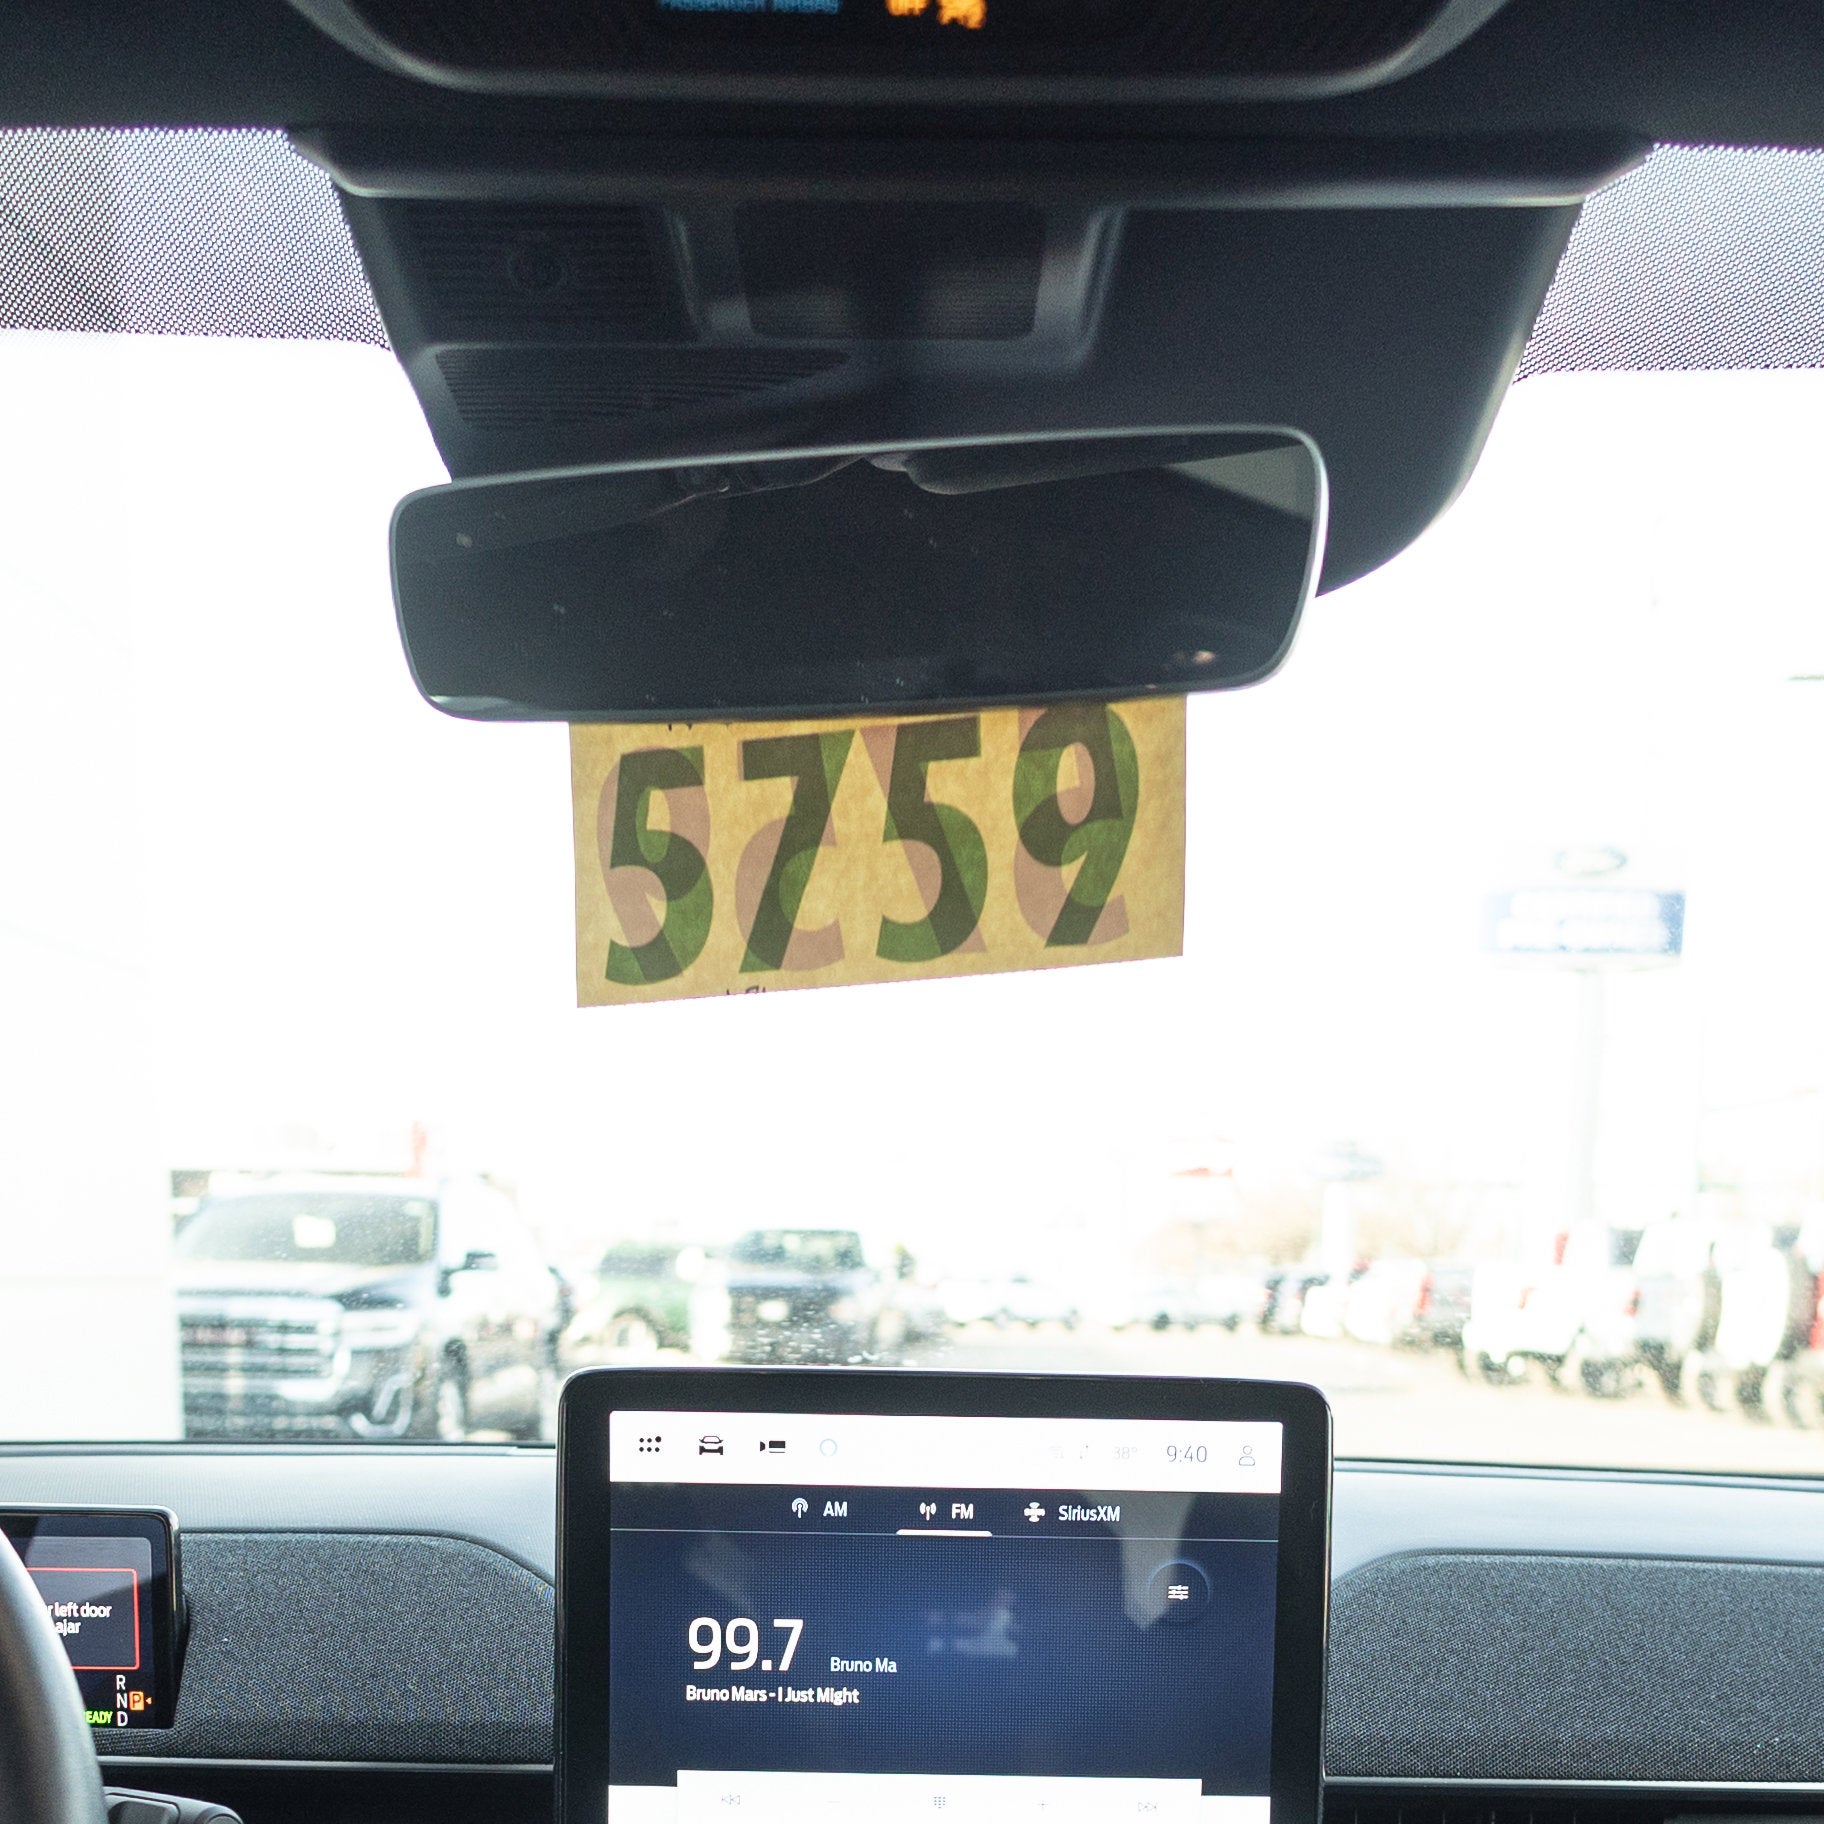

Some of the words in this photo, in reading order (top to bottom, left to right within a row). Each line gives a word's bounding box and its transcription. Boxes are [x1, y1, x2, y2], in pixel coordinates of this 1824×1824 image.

[604, 704, 1140, 986] 5759
[1166, 1443, 1209, 1463] 9:40
[822, 1501, 848, 1518] AM
[950, 1503, 974, 1521] FM
[1057, 1504, 1121, 1523] SiriusXM
[55, 1602, 79, 1618] left
[80, 1602, 112, 1618] door
[56, 1619, 82, 1634] ajar
[688, 1616, 804, 1671] 99.7
[830, 1656, 873, 1672] Bruno
[875, 1657, 898, 1673] Ma
[116, 1675, 126, 1690] R
[116, 1693, 128, 1709] N
[686, 1684, 730, 1702] Bruno
[731, 1685, 768, 1703] Mars
[784, 1686, 815, 1703] Just
[816, 1687, 860, 1706] Might
[84, 1711, 113, 1724] EADY
[117, 1711, 129, 1727] D
